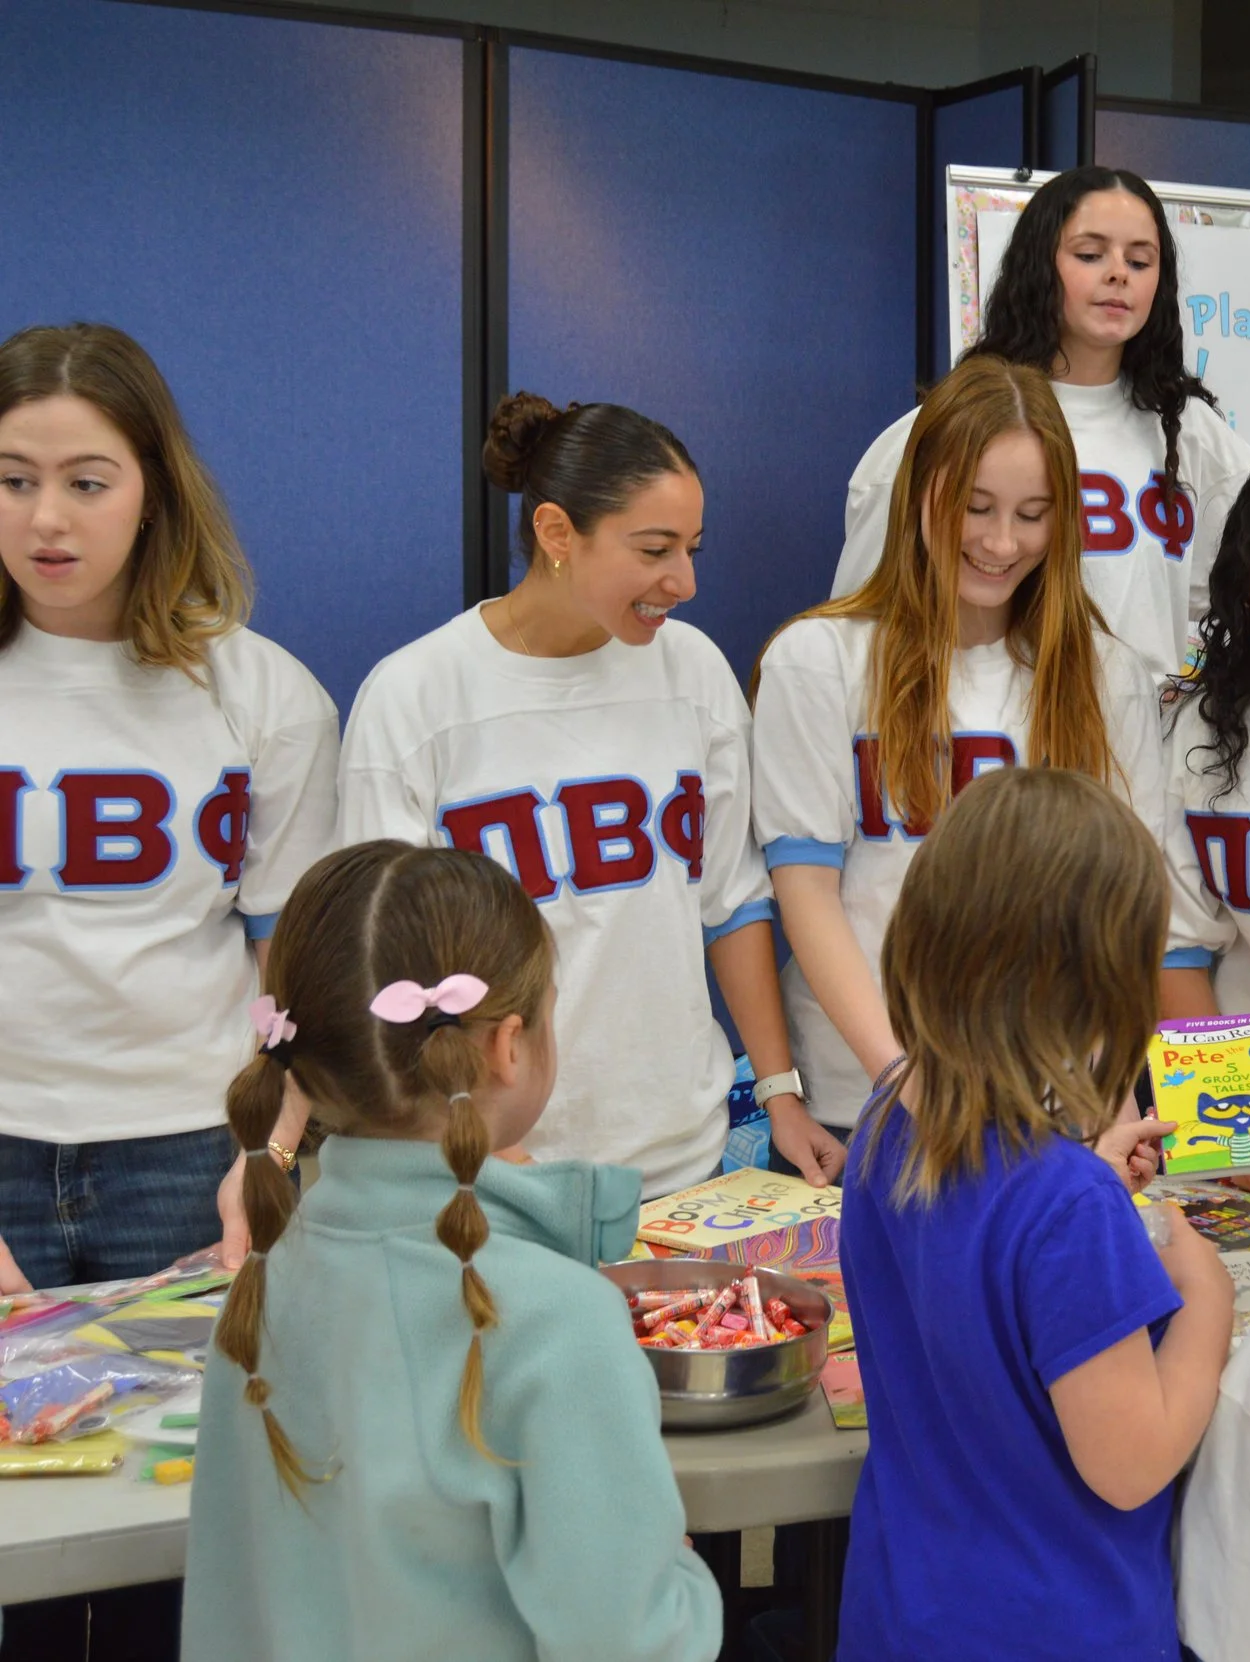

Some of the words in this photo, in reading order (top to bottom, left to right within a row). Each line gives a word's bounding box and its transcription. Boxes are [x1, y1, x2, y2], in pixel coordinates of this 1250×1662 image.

[1186, 1020, 1205, 1028] FIVE
[1207, 1019, 1236, 1027] BOOKS
[1182, 1034, 1188, 1043] I
[1192, 1033, 1226, 1043] Can
[1163, 1049, 1225, 1067] Pete
[1225, 1045, 1245, 1055] the
[1226, 1062, 1239, 1074] 5
